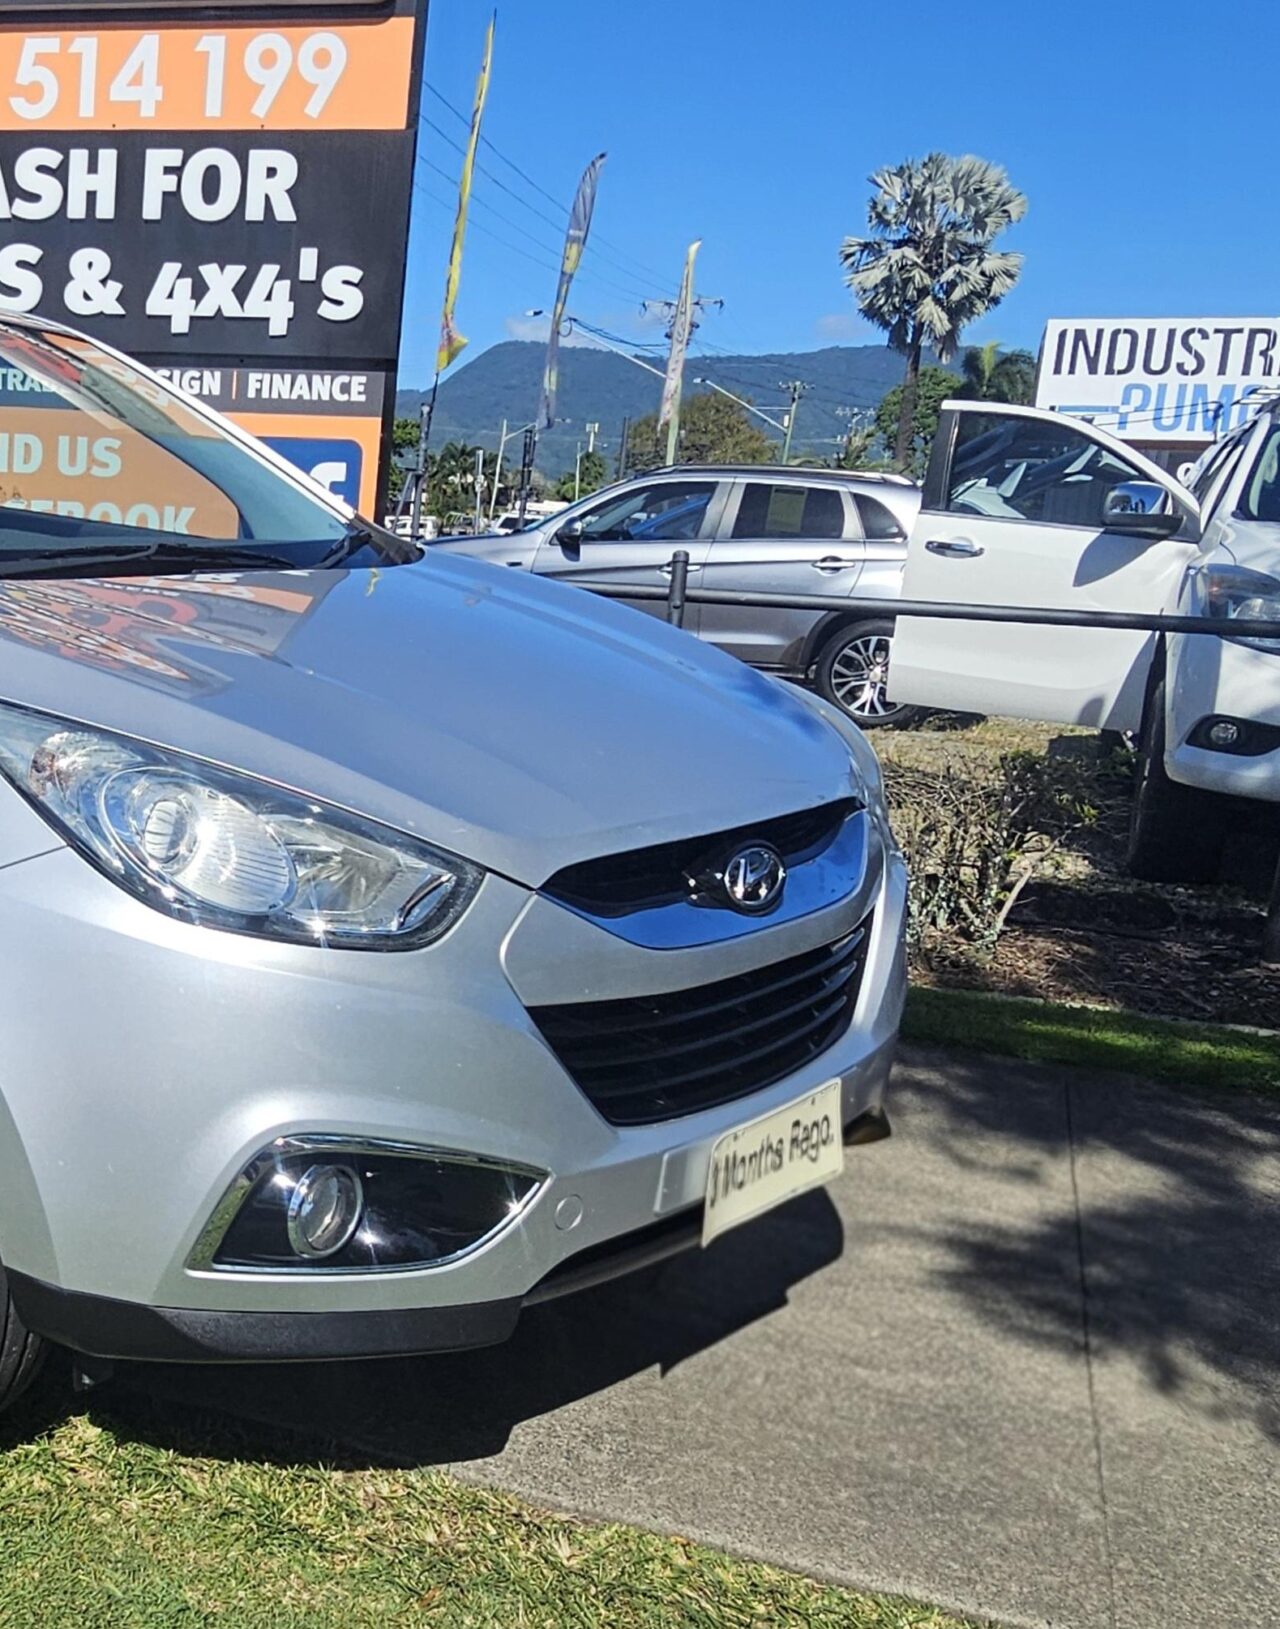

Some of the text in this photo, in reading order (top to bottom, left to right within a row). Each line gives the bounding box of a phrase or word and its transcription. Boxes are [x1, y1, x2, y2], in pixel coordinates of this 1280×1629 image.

[9, 34, 163, 120] 514
[195, 32, 347, 119] 199
[142, 148, 298, 222] FOR
[64, 247, 125, 316] &
[1053, 327, 1280, 376] INDUSTR
[247, 373, 368, 402] FINANCE
[57, 435, 122, 478] US
[721, 1133, 784, 1199] Months
